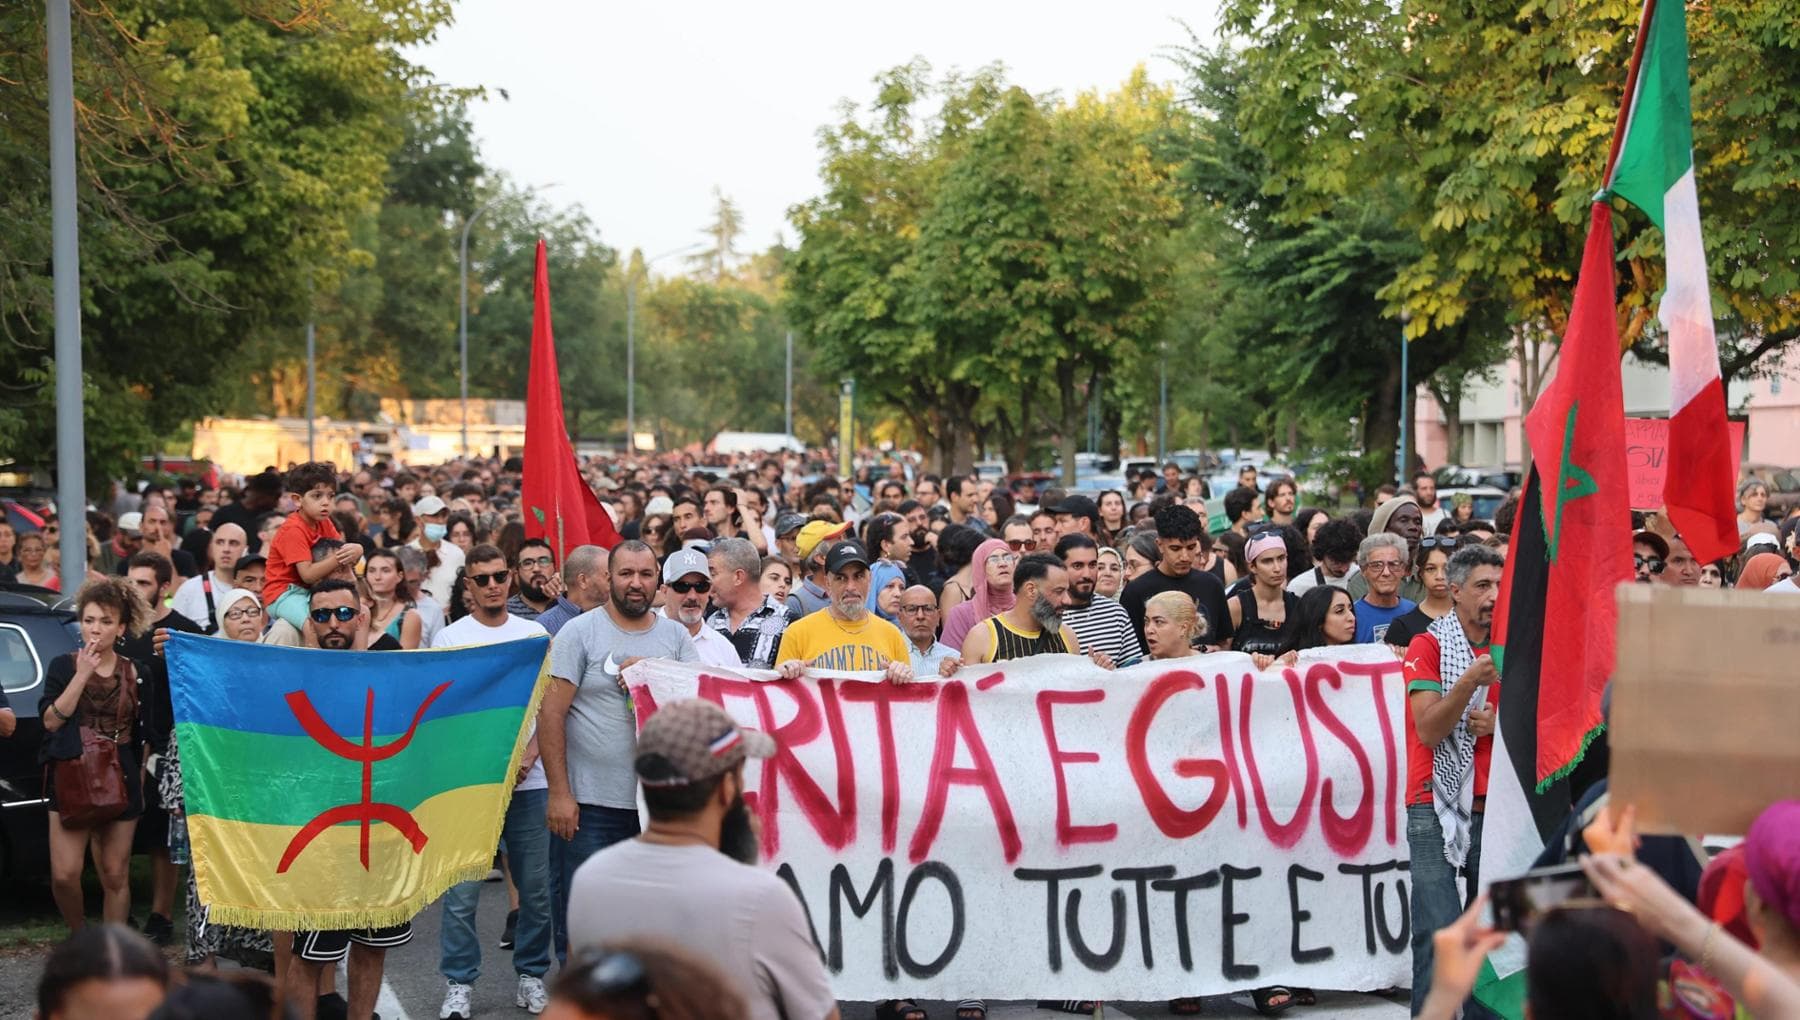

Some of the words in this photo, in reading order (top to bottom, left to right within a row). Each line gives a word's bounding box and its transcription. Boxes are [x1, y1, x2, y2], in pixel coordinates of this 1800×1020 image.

[1036, 689, 1118, 847] E
[1013, 862, 1262, 981] TUTTE
[1288, 863, 1334, 963] E
[1338, 858, 1410, 955] TU
